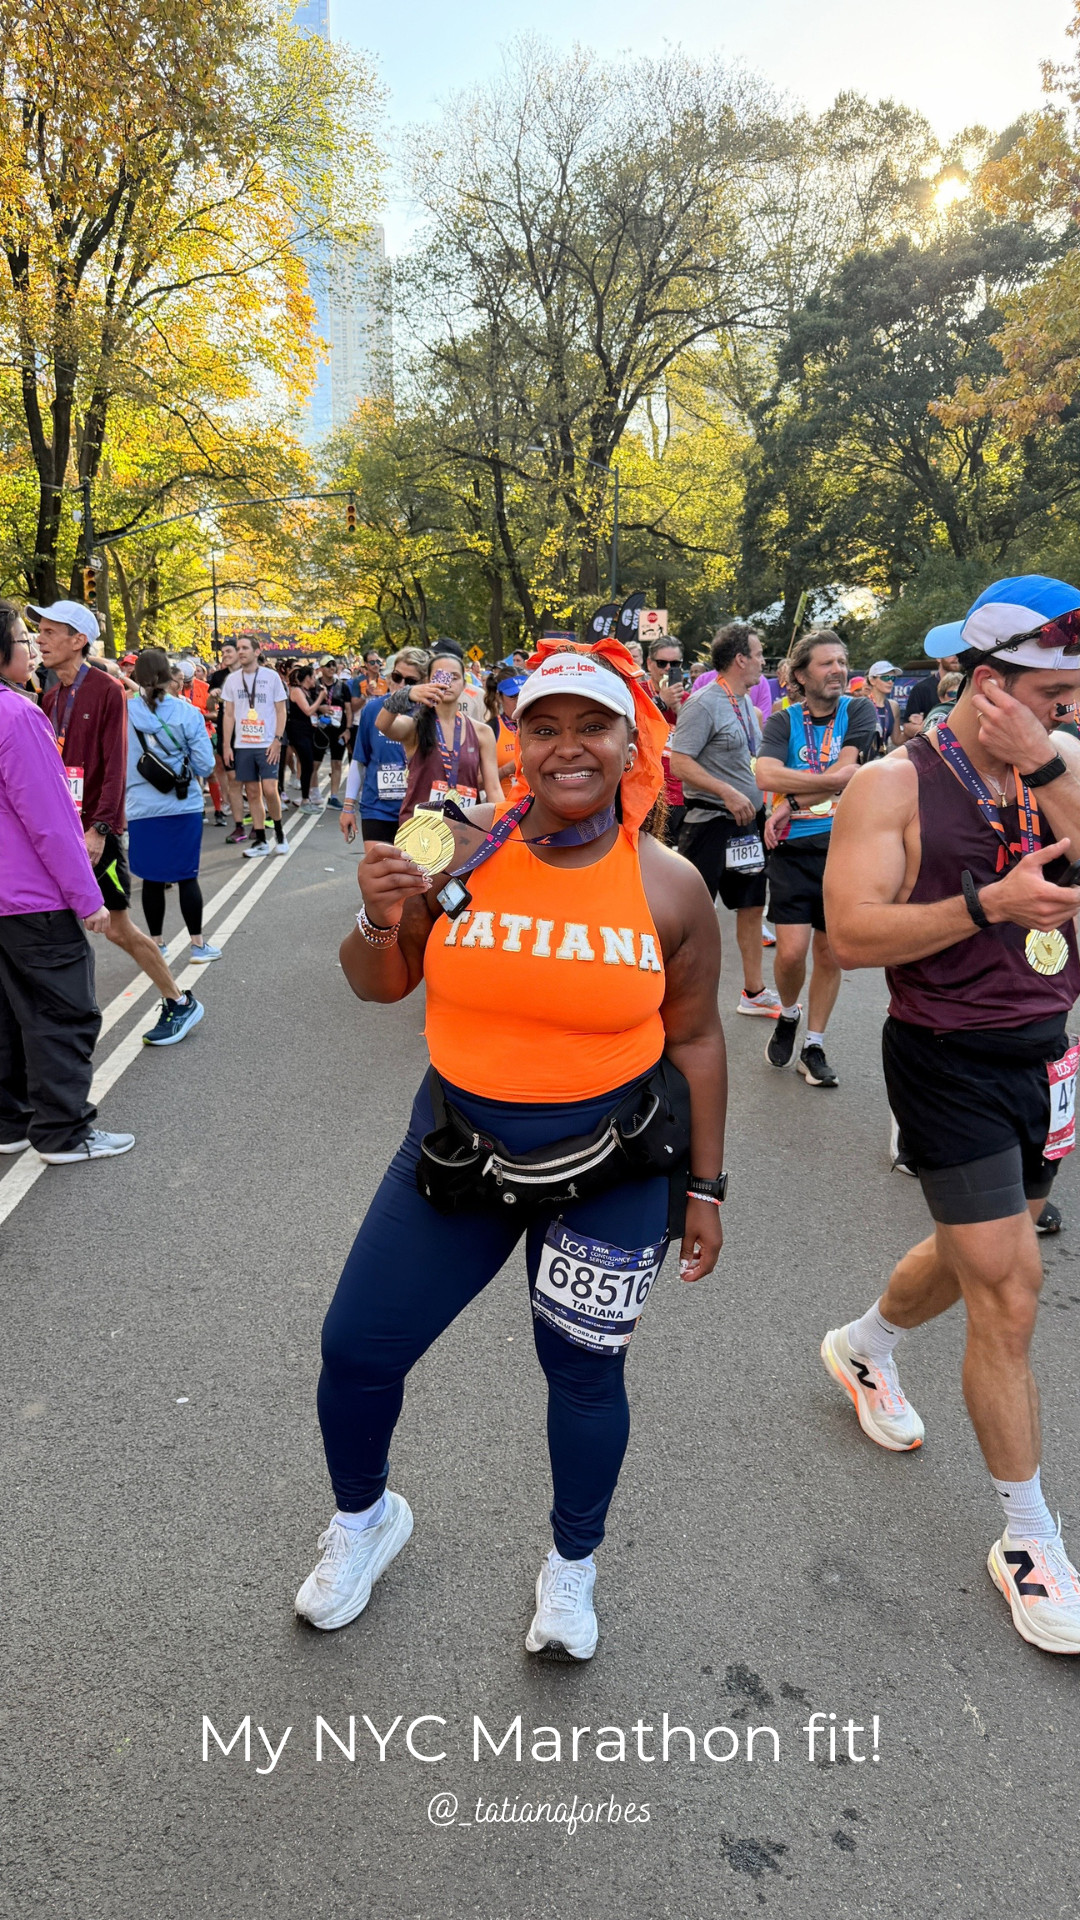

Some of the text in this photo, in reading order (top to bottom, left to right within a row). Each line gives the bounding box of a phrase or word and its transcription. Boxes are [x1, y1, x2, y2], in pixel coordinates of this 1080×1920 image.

[541, 665, 564, 676] best
[577, 662, 596, 673] last
[732, 845, 760, 861] 11812
[444, 910, 662, 973] TATIANA
[560, 1233, 588, 1259] tcs
[592, 1245, 610, 1255] TATA
[589, 1257, 615, 1267] SERVICES
[637, 1259, 654, 1267] TATA
[548, 1256, 653, 1307] 68516
[572, 1299, 624, 1319] TATIANA
[572, 1327, 598, 1341] CORRAL
